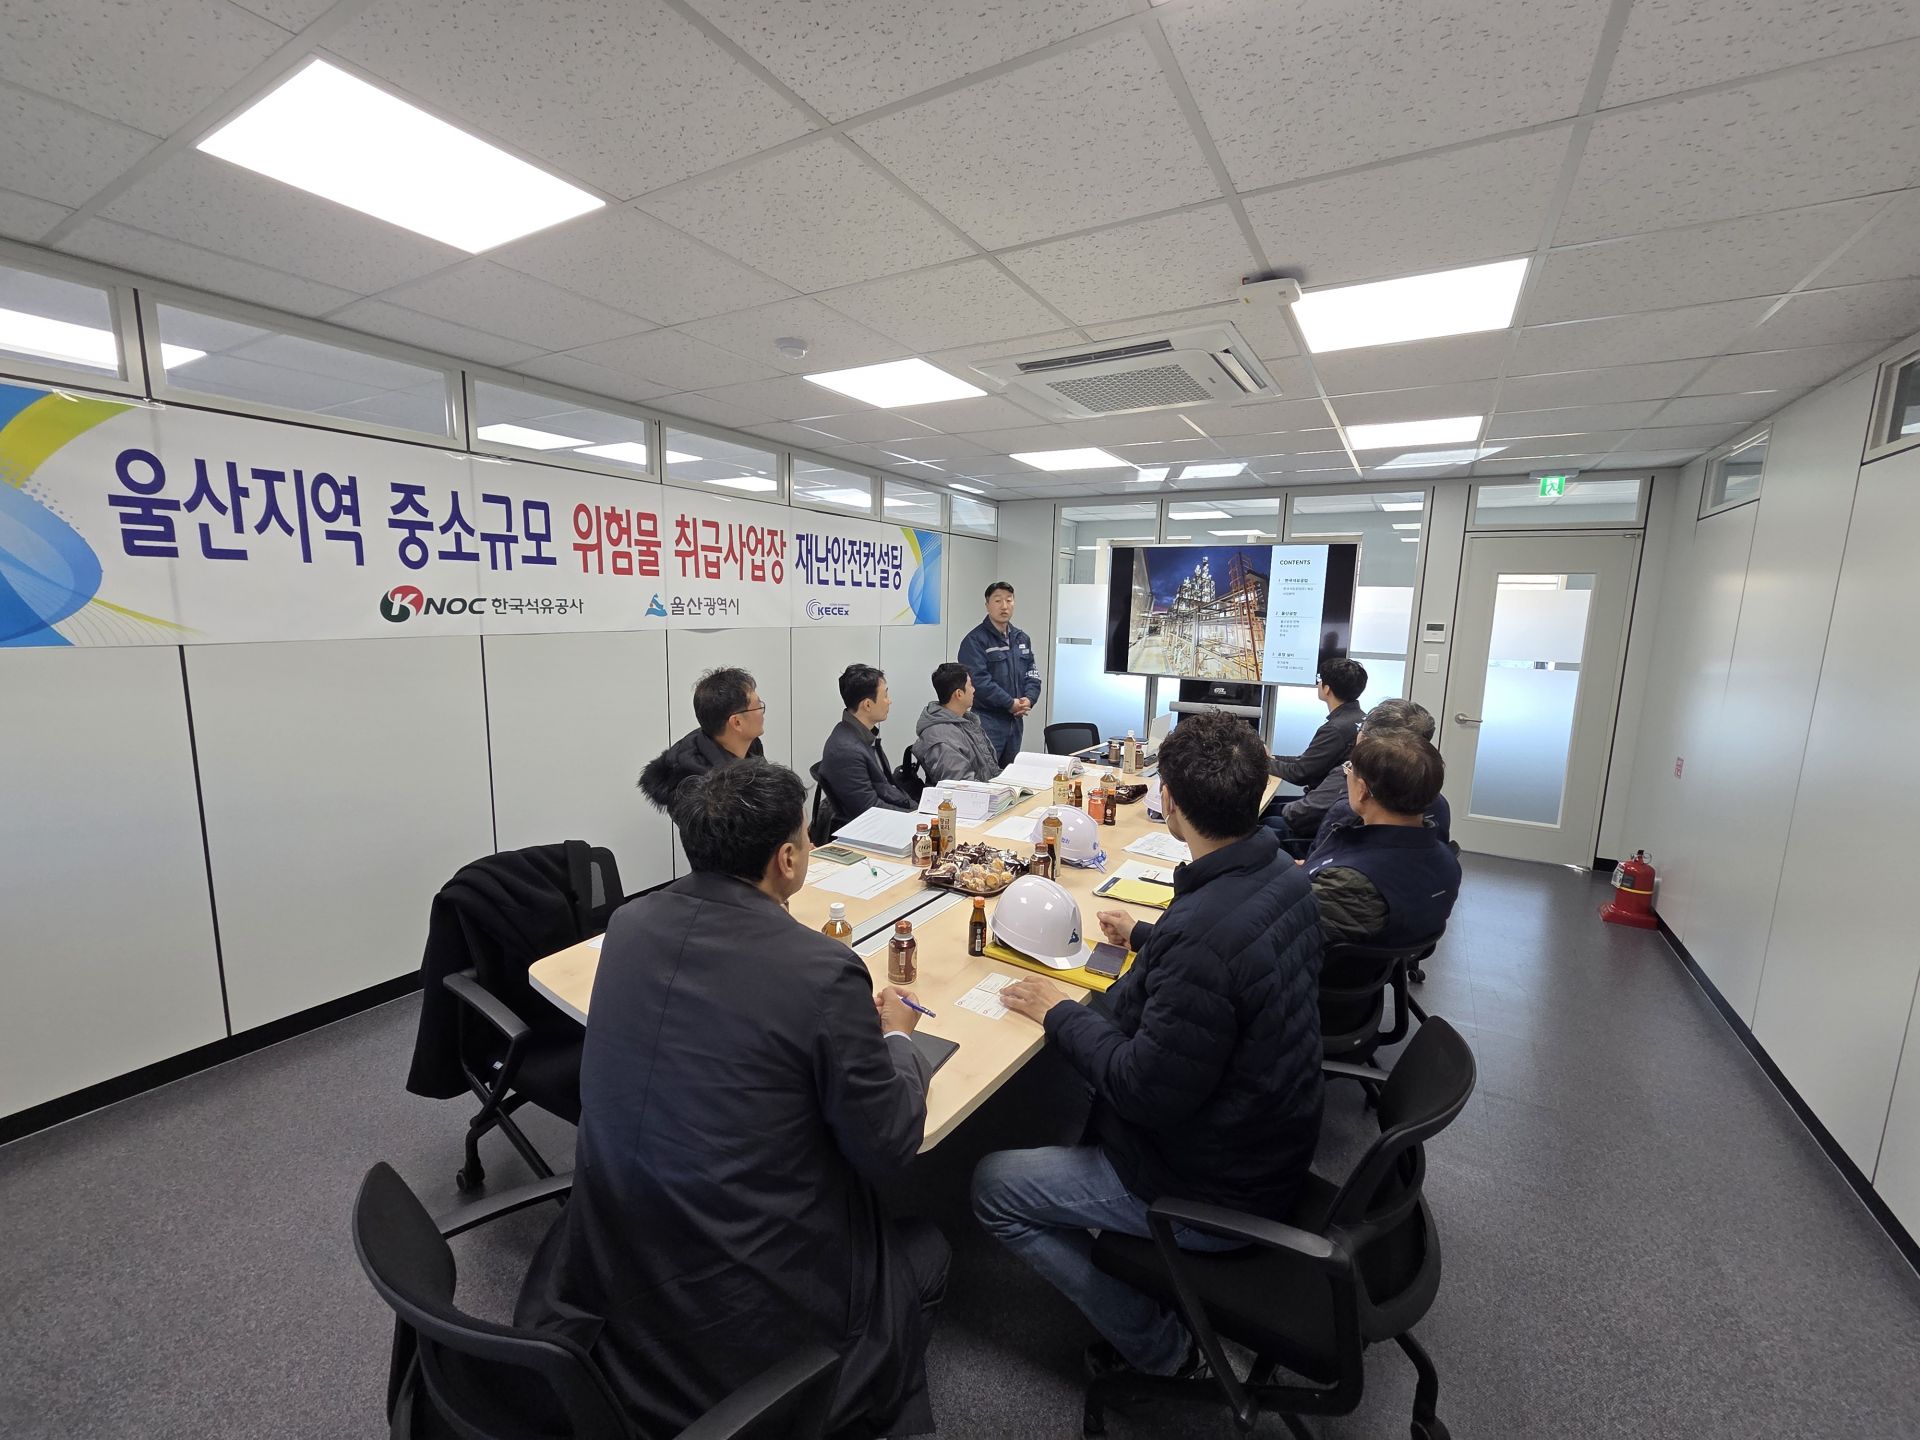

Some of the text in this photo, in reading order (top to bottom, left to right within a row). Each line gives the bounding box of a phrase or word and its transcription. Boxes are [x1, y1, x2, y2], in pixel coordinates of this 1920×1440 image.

[107, 448, 903, 591] 울산지역 중소규모 위험물 취급사업장 재난안전컨설팅
[491, 598, 584, 615] 한국석유공사
[670, 596, 739, 616] 울산광역시
